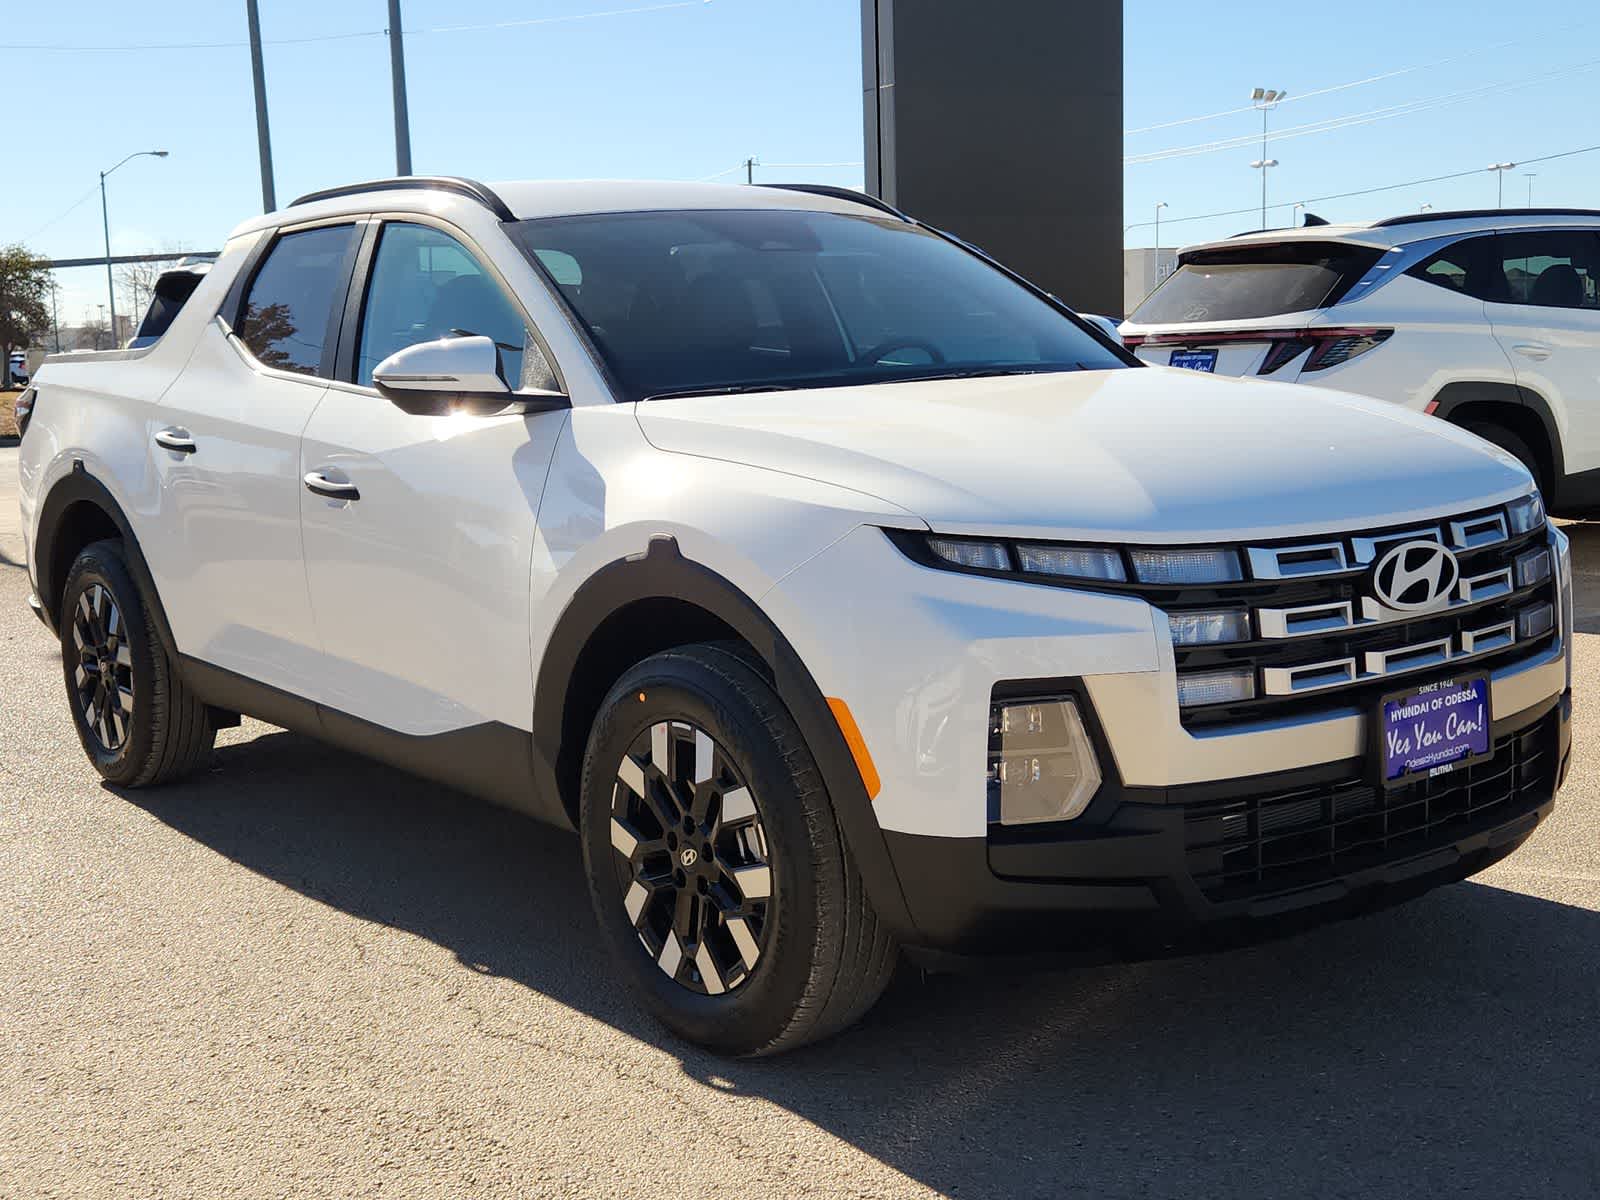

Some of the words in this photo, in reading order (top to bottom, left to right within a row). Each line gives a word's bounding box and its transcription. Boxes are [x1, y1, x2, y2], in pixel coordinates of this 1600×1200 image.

[1391, 702, 1429, 723] HYUNDAI
[1431, 698, 1443, 711] OF
[1445, 688, 1478, 706] ODESSA
[1419, 682, 1438, 695] SINCE
[1387, 728, 1411, 759] Yes
[1414, 721, 1442, 750] You
[1446, 703, 1483, 740] Can!
